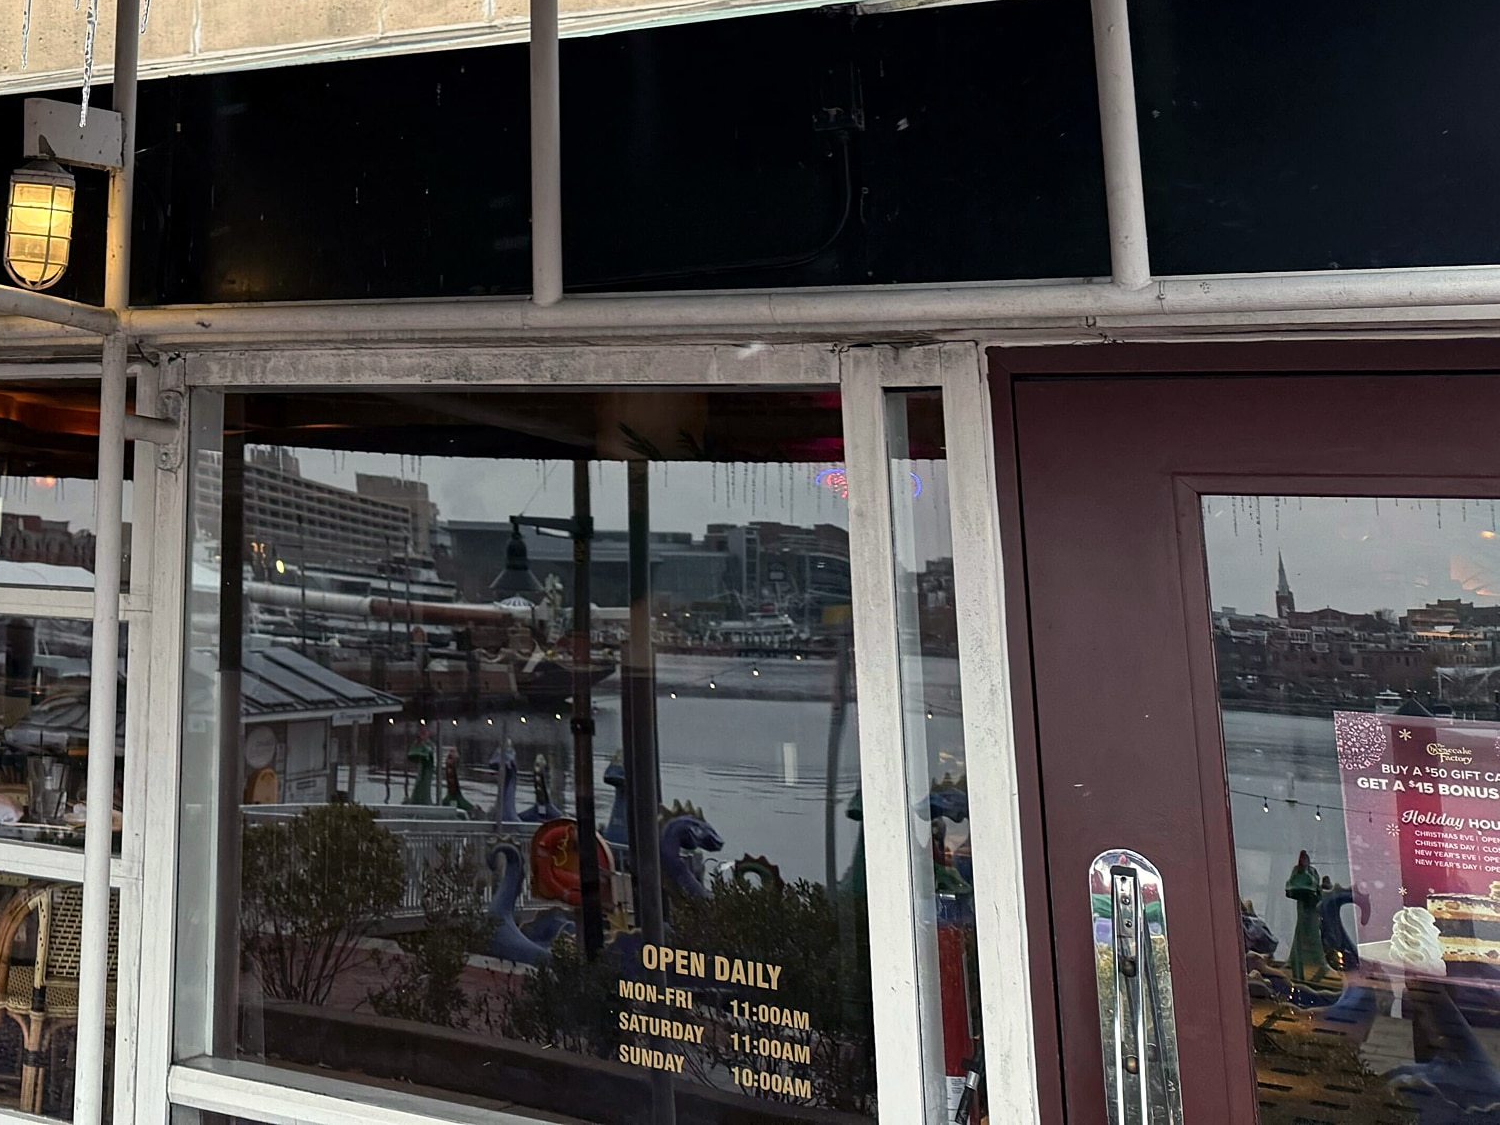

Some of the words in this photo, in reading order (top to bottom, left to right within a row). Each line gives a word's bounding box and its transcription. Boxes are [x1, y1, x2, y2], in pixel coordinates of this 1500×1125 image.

[1440, 752, 1473, 765] Factory
[1381, 763, 1409, 775] BUY
[1412, 766, 1423, 776] A
[1424, 766, 1447, 778] $50
[1451, 769, 1481, 781] GIFT
[1356, 777, 1389, 790] GET
[1393, 779, 1406, 792] A
[1408, 780, 1434, 794] $15
[1438, 783, 1500, 800] BONUS
[1401, 809, 1465, 830] Holiday
[1414, 830, 1458, 840] CHRISTMAS
[1460, 834, 1475, 842] EVE
[1414, 839, 1459, 850] CHRISTMAS
[1460, 843, 1475, 851] DAY
[1414, 849, 1433, 857] NEW
[1433, 850, 1460, 859] YEAR'S
[1461, 853, 1477, 861] EVE
[1415, 858, 1433, 866] NEW
[1433, 860, 1461, 869] YEAR'S
[642, 944, 706, 978] OPEN
[714, 955, 783, 991] DAILY
[618, 979, 694, 1011] MON-FRI
[729, 999, 810, 1031] 11:00AM
[618, 1012, 705, 1044] SATURDAY
[730, 1032, 811, 1065] 11:00AM
[618, 1044, 685, 1074] SUNDAY
[731, 1066, 812, 1100] 10:00AM
